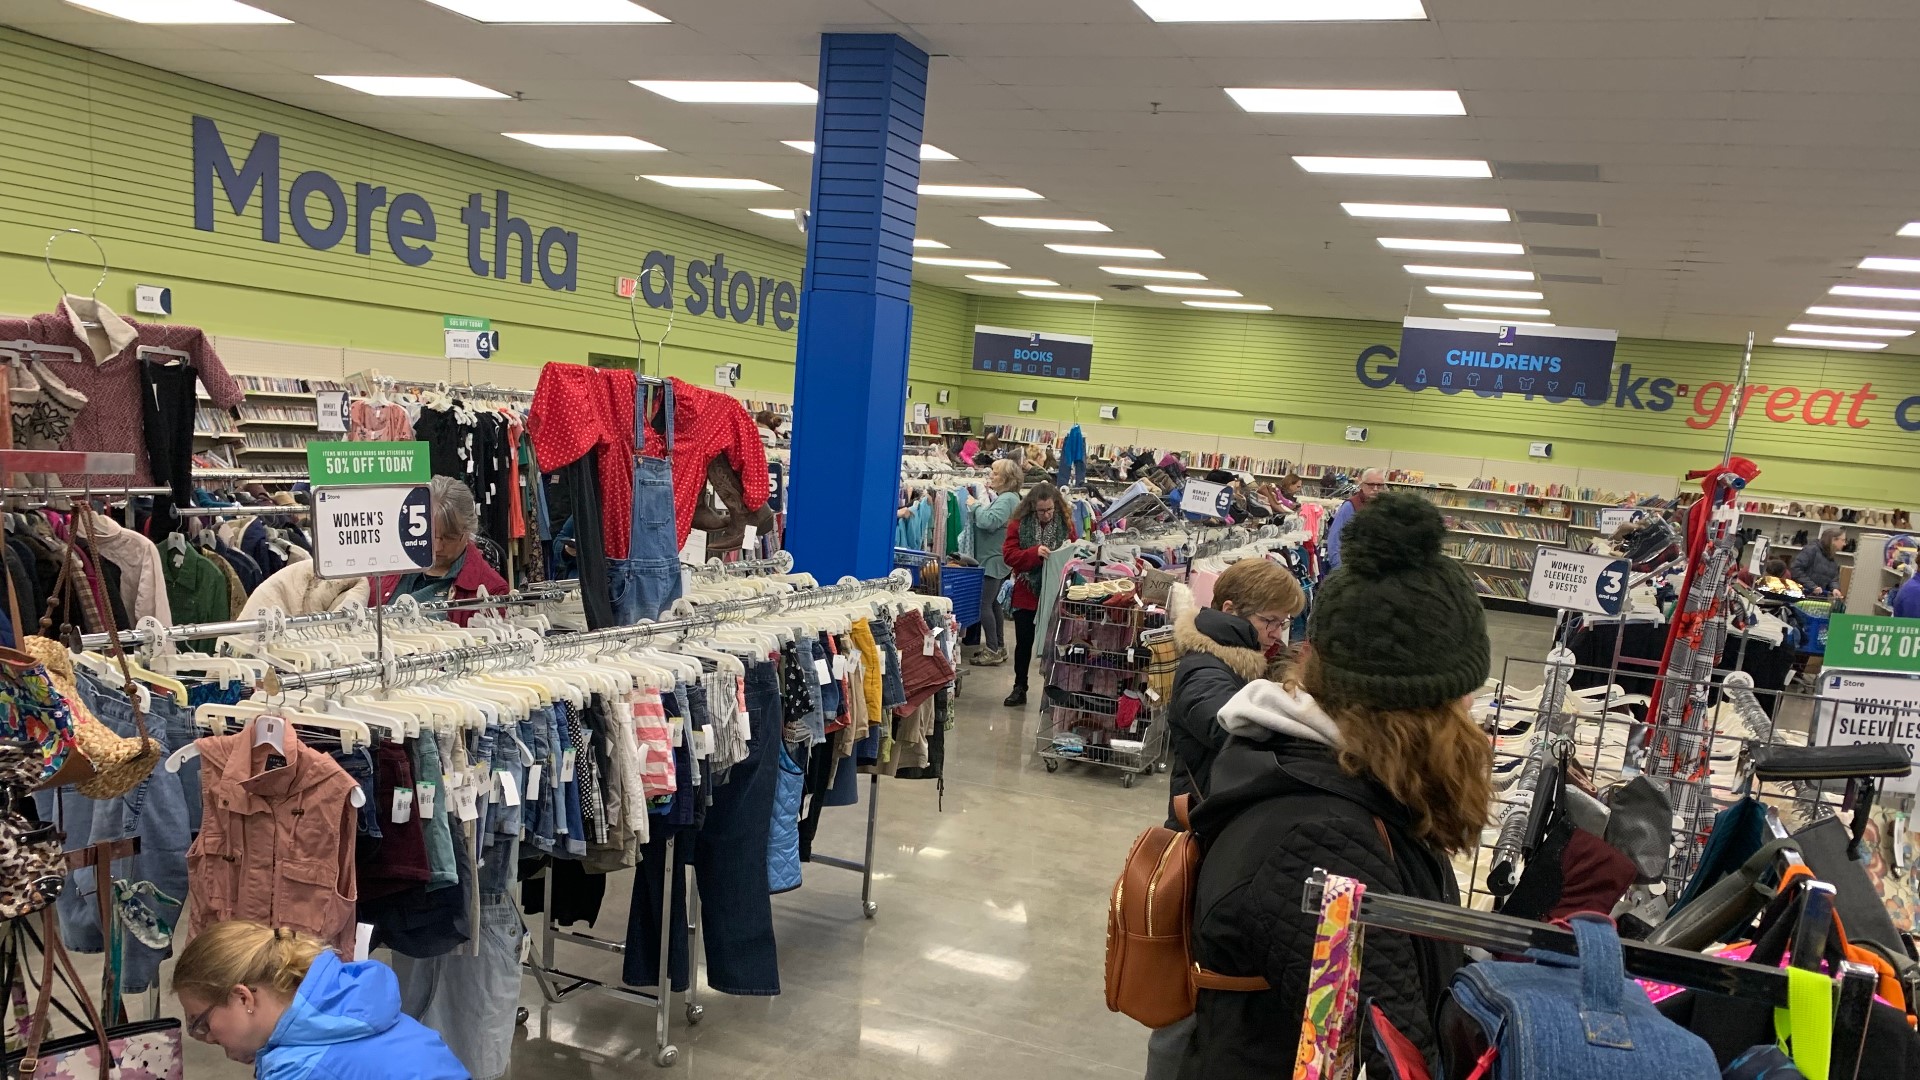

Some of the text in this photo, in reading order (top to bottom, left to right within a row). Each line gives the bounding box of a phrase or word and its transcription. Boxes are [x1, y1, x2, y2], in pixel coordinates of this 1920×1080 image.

[192, 115, 797, 332] More tha a store
[1014, 348, 1054, 362] BOOKS
[1446, 350, 1562, 373] CHILDREN'S
[1685, 381, 1878, 430] great
[326, 456, 413, 474] 50% OFF TODAY
[333, 512, 384, 528] WOMEN'S
[338, 529, 381, 546] SHORTS
[1551, 560, 1585, 573] WOMEN'S
[1544, 570, 1588, 585] SLEEVELESS
[1549, 581, 1578, 593] & VESTS
[1852, 624, 1874, 632] ITEMS
[1853, 633, 1892, 656] 50%
[1855, 698, 1920, 717] WOMEN'
